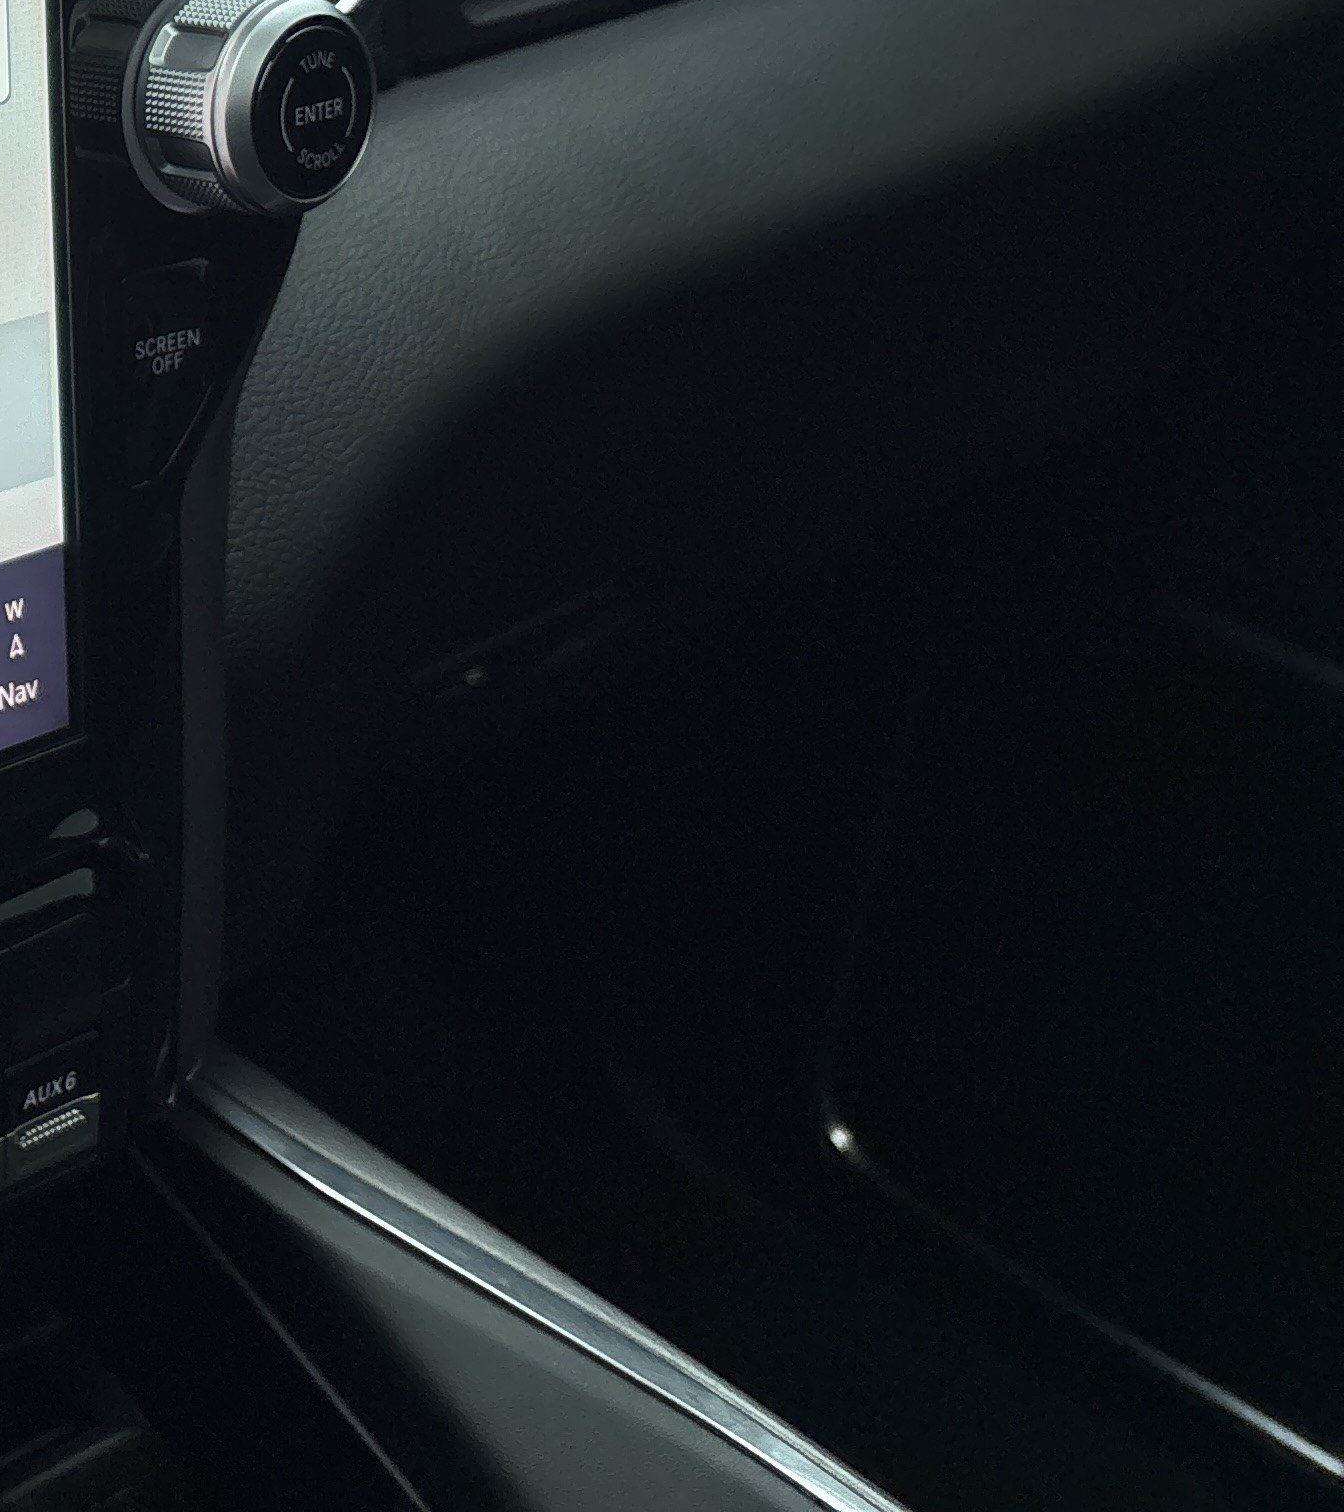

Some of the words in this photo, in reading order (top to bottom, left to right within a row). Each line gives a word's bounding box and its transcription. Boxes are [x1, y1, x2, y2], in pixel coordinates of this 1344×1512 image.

[298, 49, 337, 74] TUNE
[294, 96, 343, 127] ENTER
[135, 327, 201, 360] SCREEN
[151, 350, 185, 376] OFF
[4, 598, 24, 621] W
[23, 1076, 62, 1110] AUX
[64, 1071, 78, 1090] 6
